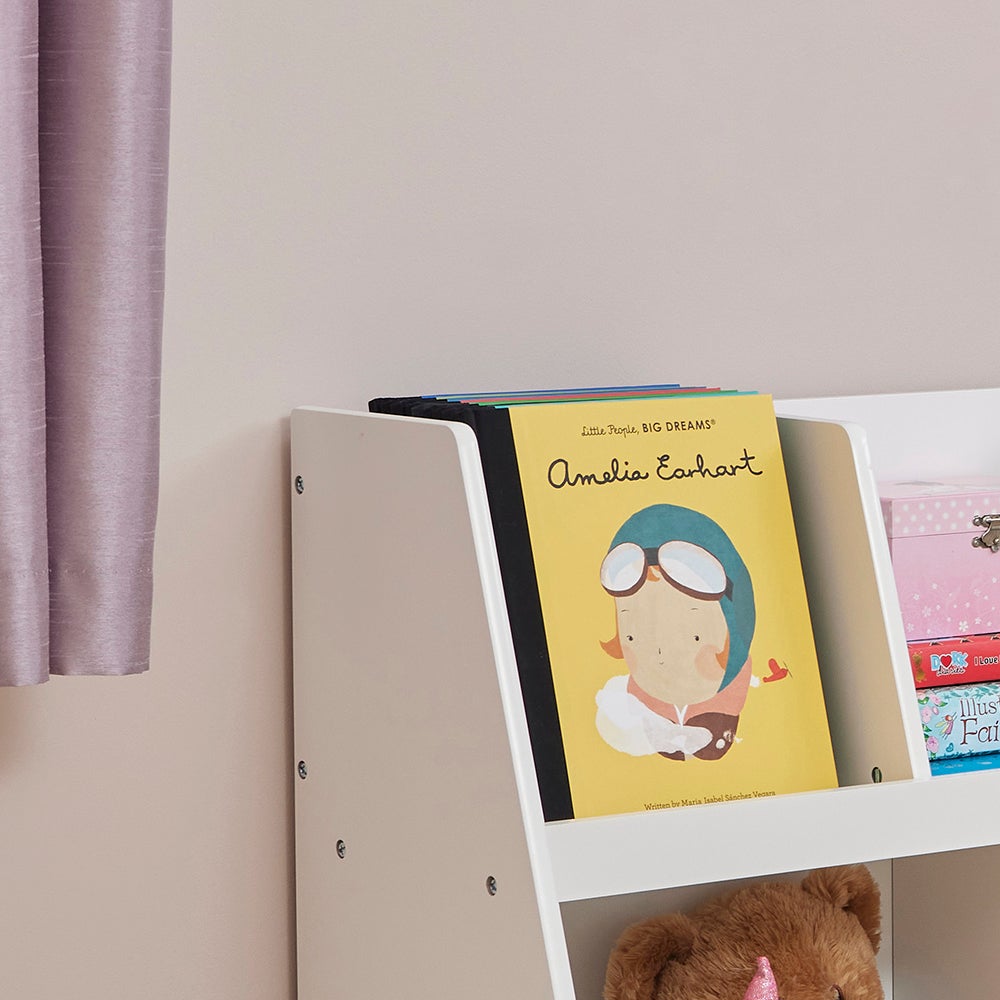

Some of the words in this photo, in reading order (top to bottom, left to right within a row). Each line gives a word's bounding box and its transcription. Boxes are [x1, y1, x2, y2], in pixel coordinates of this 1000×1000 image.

[581, 424, 606, 437] Little
[607, 423, 640, 438] People,
[642, 422, 662, 433] BIG
[547, 457, 650, 488] Amelia
[655, 448, 763, 480] Earhart
[979, 655, 999, 665] Love
[644, 803, 671, 811] Written
[704, 796, 724, 804] Isabel
[725, 793, 752, 801] Sánchez
